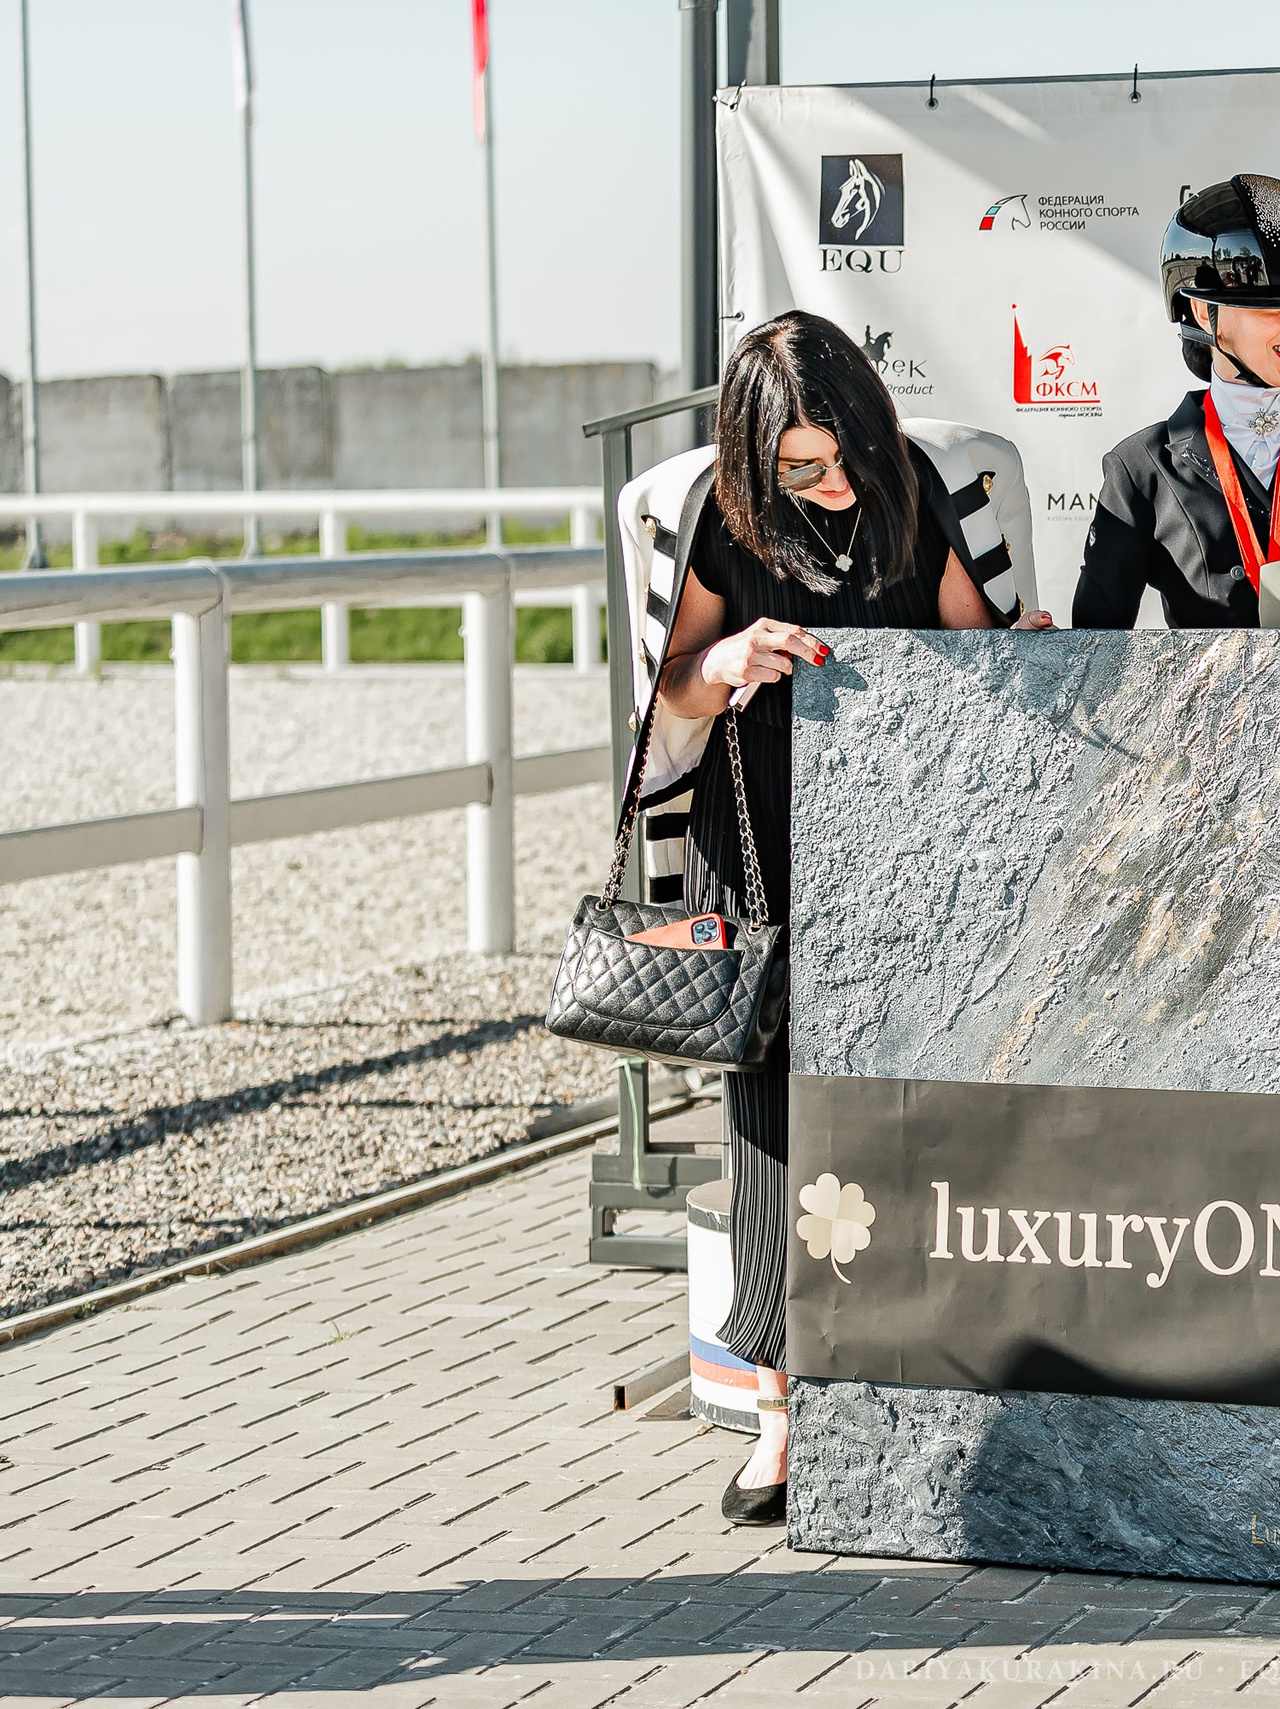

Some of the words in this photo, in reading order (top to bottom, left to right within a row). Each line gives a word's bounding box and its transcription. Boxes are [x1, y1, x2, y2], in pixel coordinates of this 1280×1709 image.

[1038, 195, 1104, 207] ФЕДЕРАЦИЯ
[1039, 207, 1093, 219] КОННОГО
[1095, 206, 1139, 218] СПОРТА
[1040, 219, 1086, 230] РОССИИ
[819, 248, 906, 273] EQU
[1036, 381, 1097, 397] ФКСМ
[1047, 493, 1098, 510] MAN
